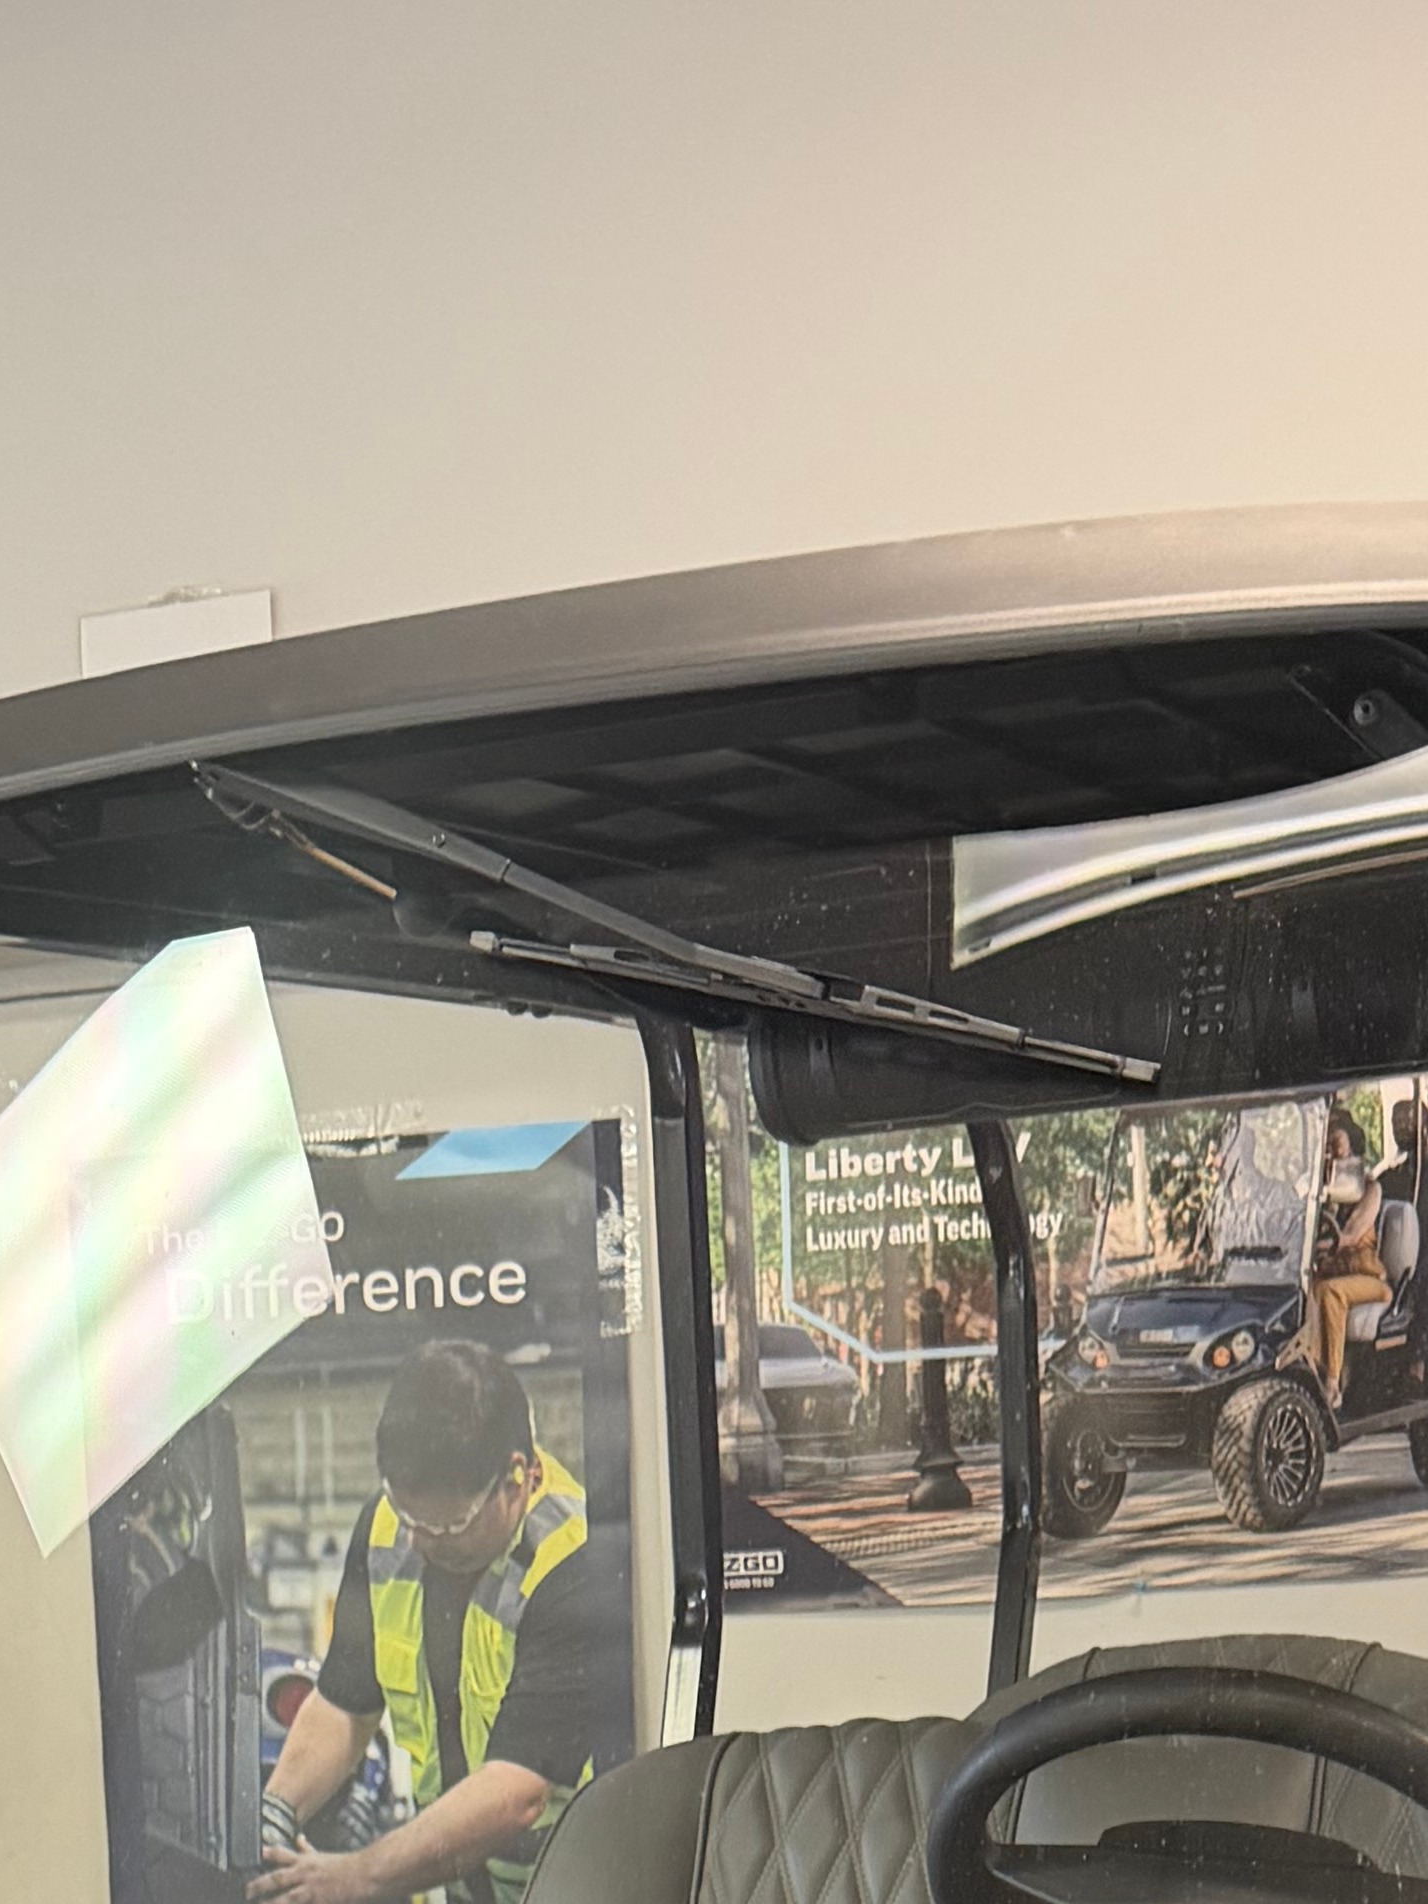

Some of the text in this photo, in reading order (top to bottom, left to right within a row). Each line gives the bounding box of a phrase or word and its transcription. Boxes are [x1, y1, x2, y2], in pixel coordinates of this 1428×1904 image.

[805, 1142, 942, 1182] Liberty
[806, 1222, 884, 1252] Luxury
[888, 1217, 930, 1246] and
[164, 1259, 527, 1325] Difference
